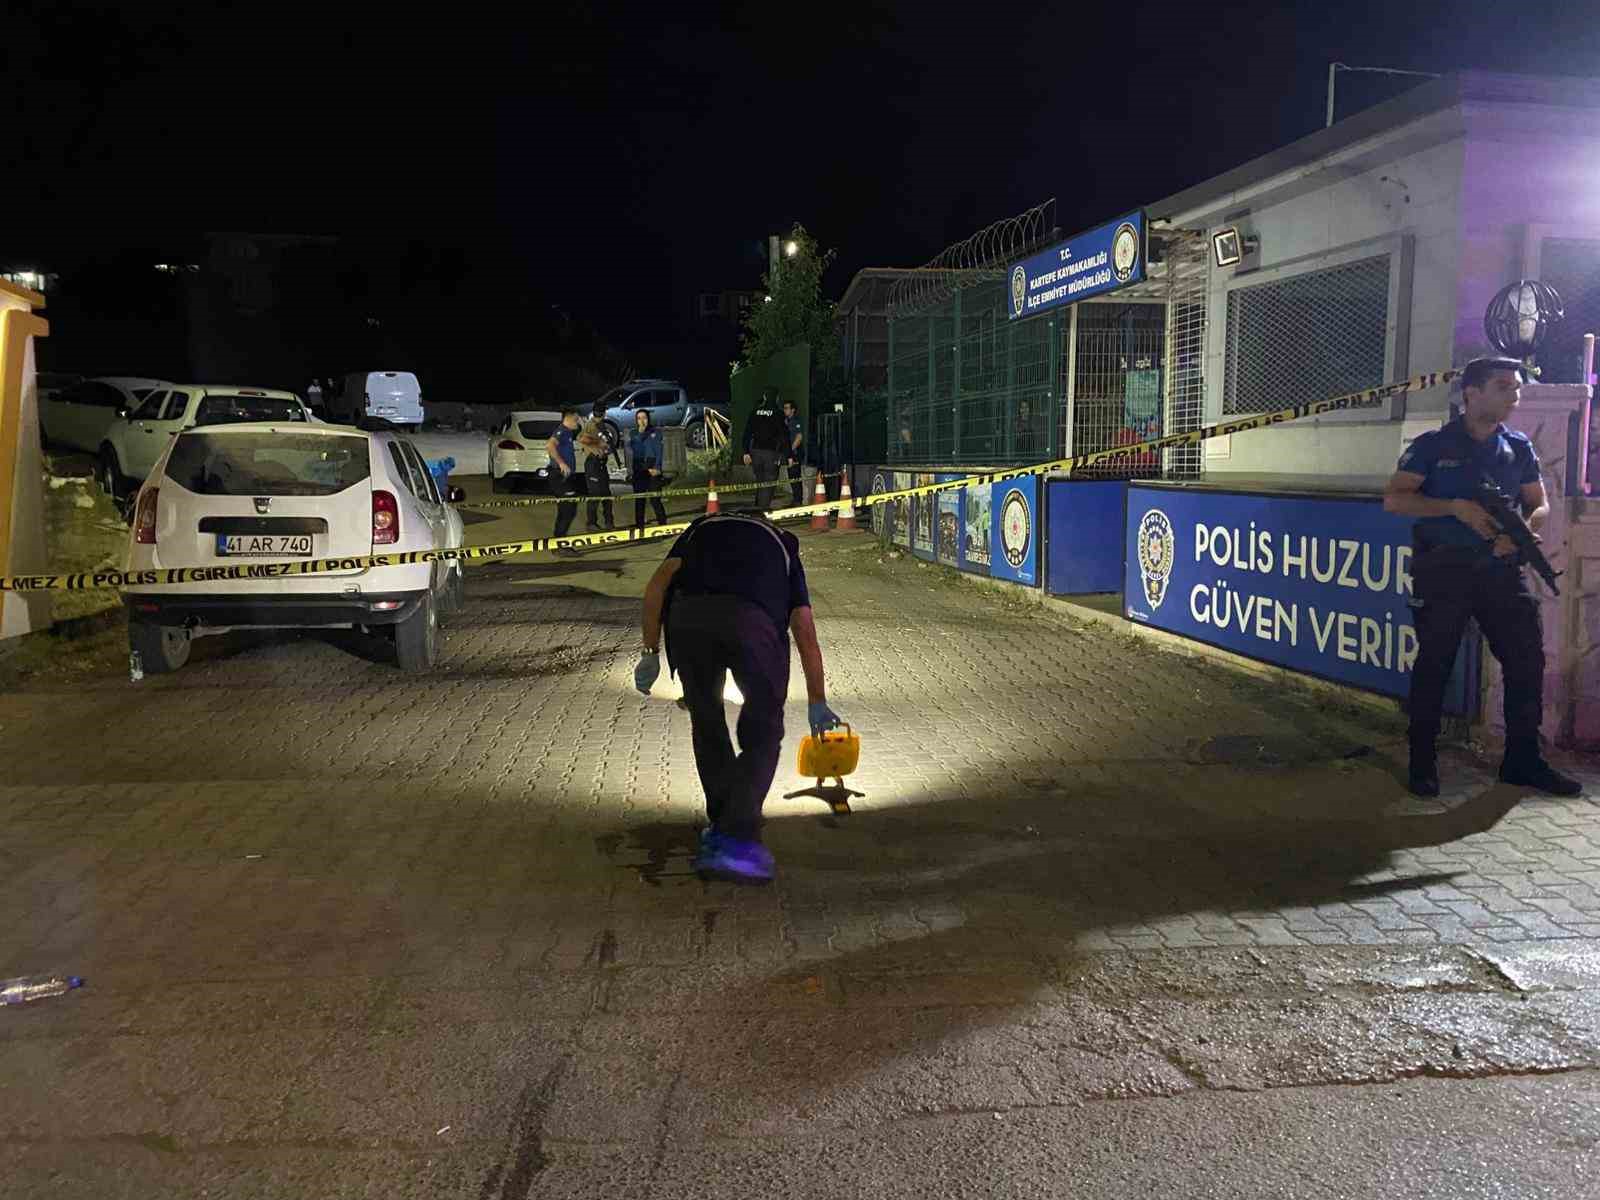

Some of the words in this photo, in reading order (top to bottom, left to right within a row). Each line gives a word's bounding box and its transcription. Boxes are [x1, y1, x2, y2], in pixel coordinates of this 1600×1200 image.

[1030, 271, 1057, 290] KARTEPE
[1057, 250, 1108, 280] KAYMAKAMLIĞI
[1060, 248, 1072, 260] T.C.
[1027, 295, 1041, 310] İLÇE
[1041, 285, 1067, 300] EMNİYET
[1068, 268, 1111, 294] MÜDÜRLÜĞÜ
[227, 537, 242, 551] 41
[249, 537, 273, 551] AR
[280, 537, 309, 551] 740
[1195, 521, 1274, 573] POLİS
[1283, 533, 1413, 596] HUZUR
[1190, 579, 1298, 646] GÜVEN
[1309, 611, 1420, 673] VERİR
